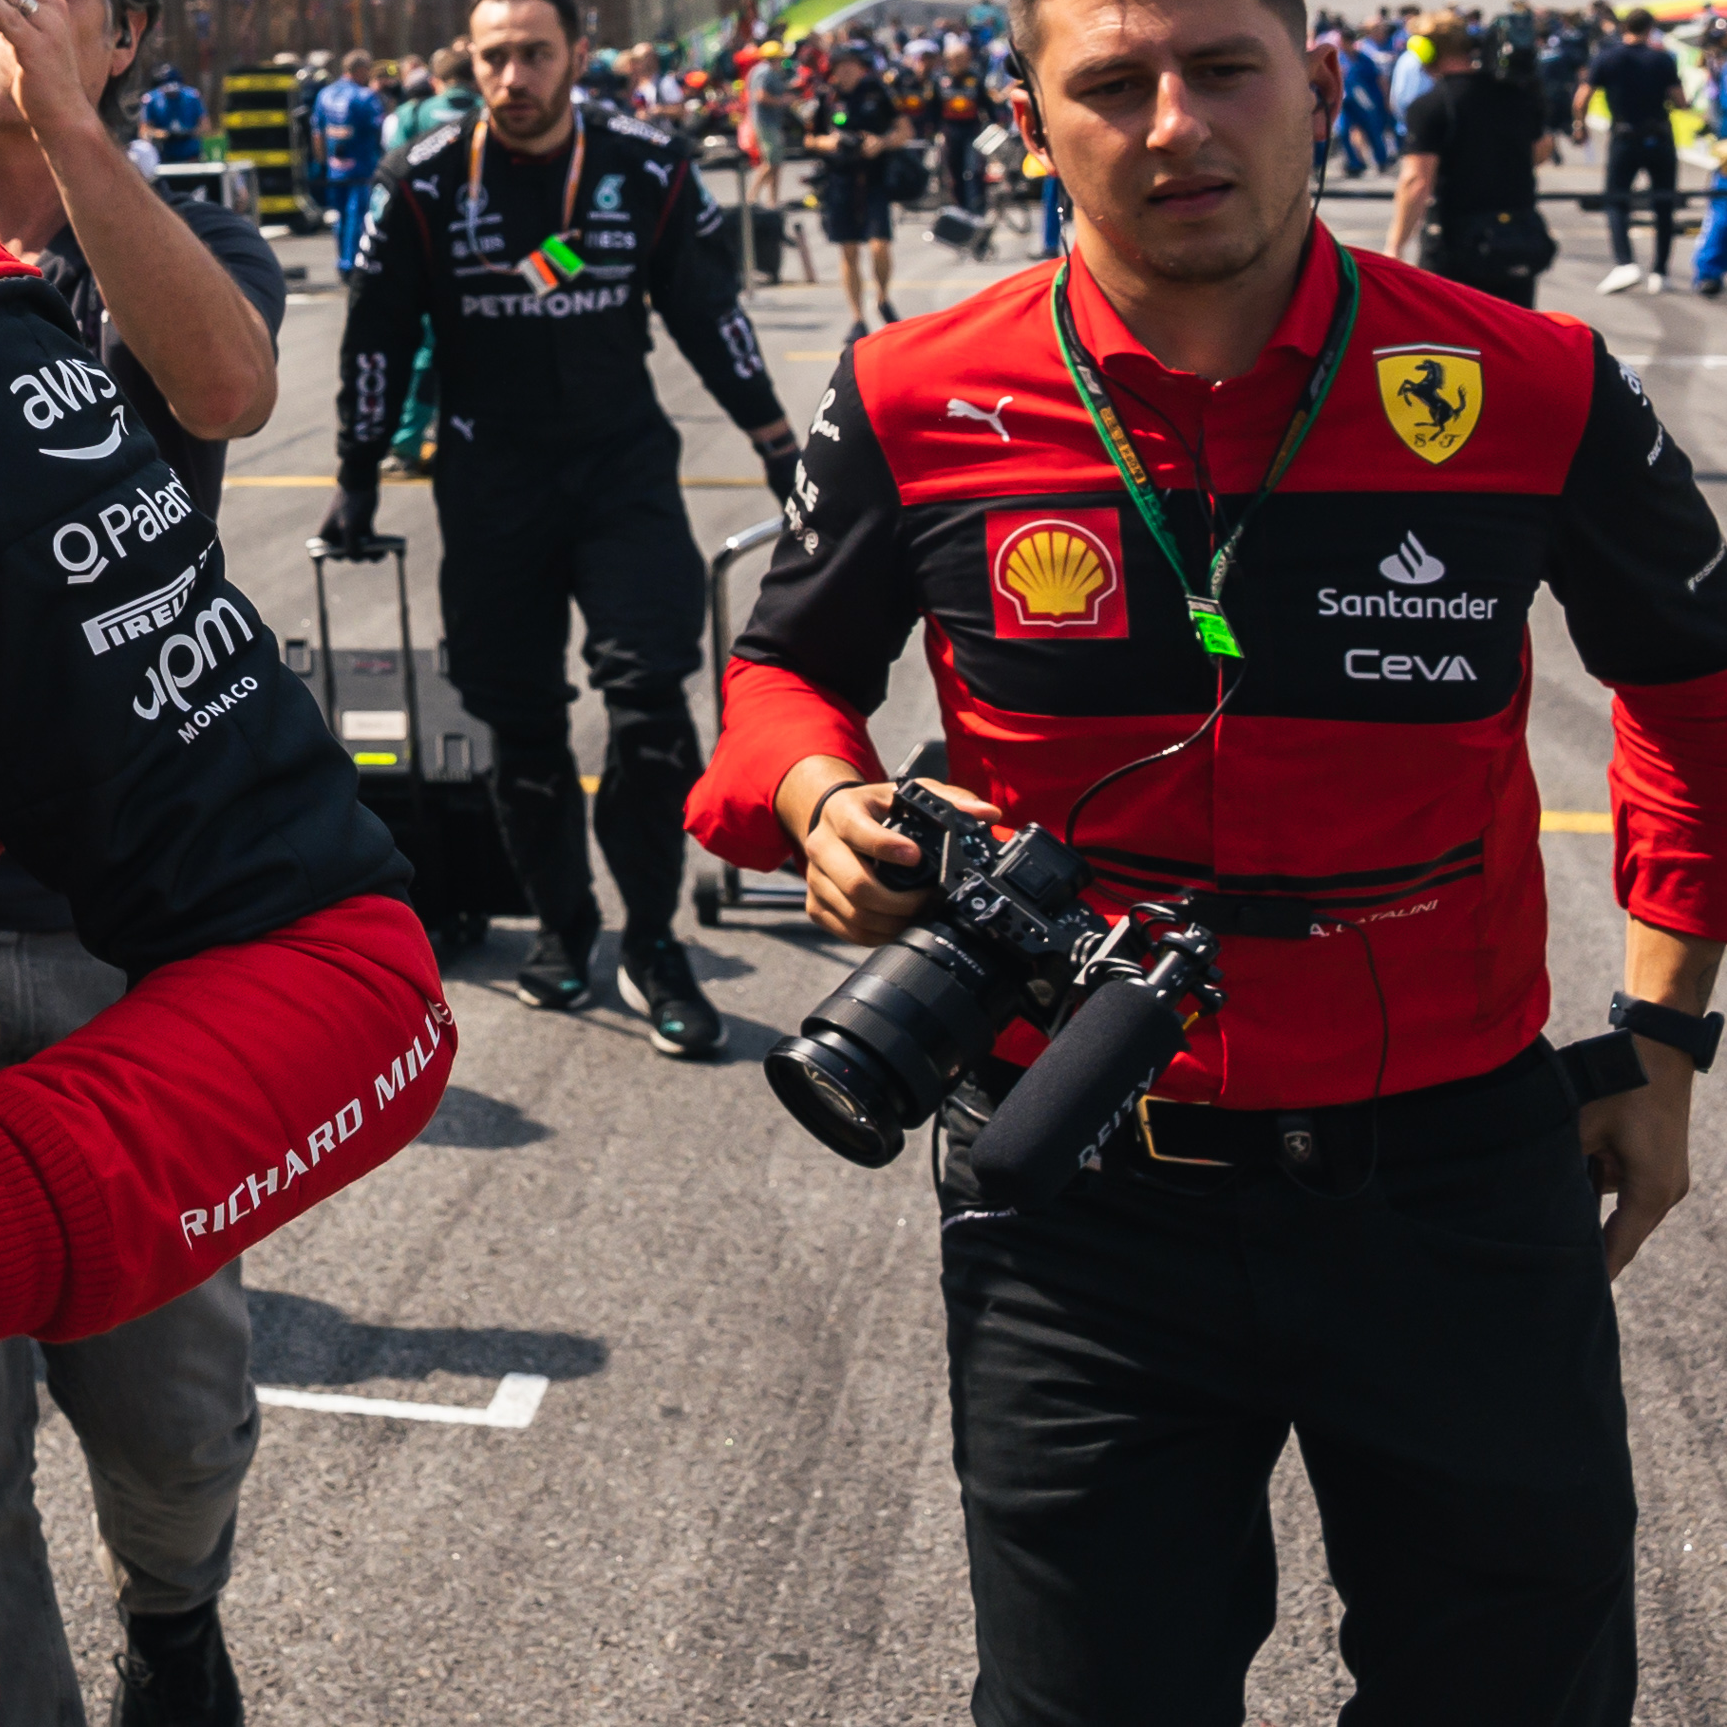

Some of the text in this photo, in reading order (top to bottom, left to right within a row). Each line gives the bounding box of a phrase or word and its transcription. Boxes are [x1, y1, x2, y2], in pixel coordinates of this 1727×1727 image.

[1317, 587, 1498, 619] Santander
[177, 676, 259, 745] MONACO
[1078, 1067, 1155, 1171] DEITY
[180, 1097, 363, 1251] RICHARD
